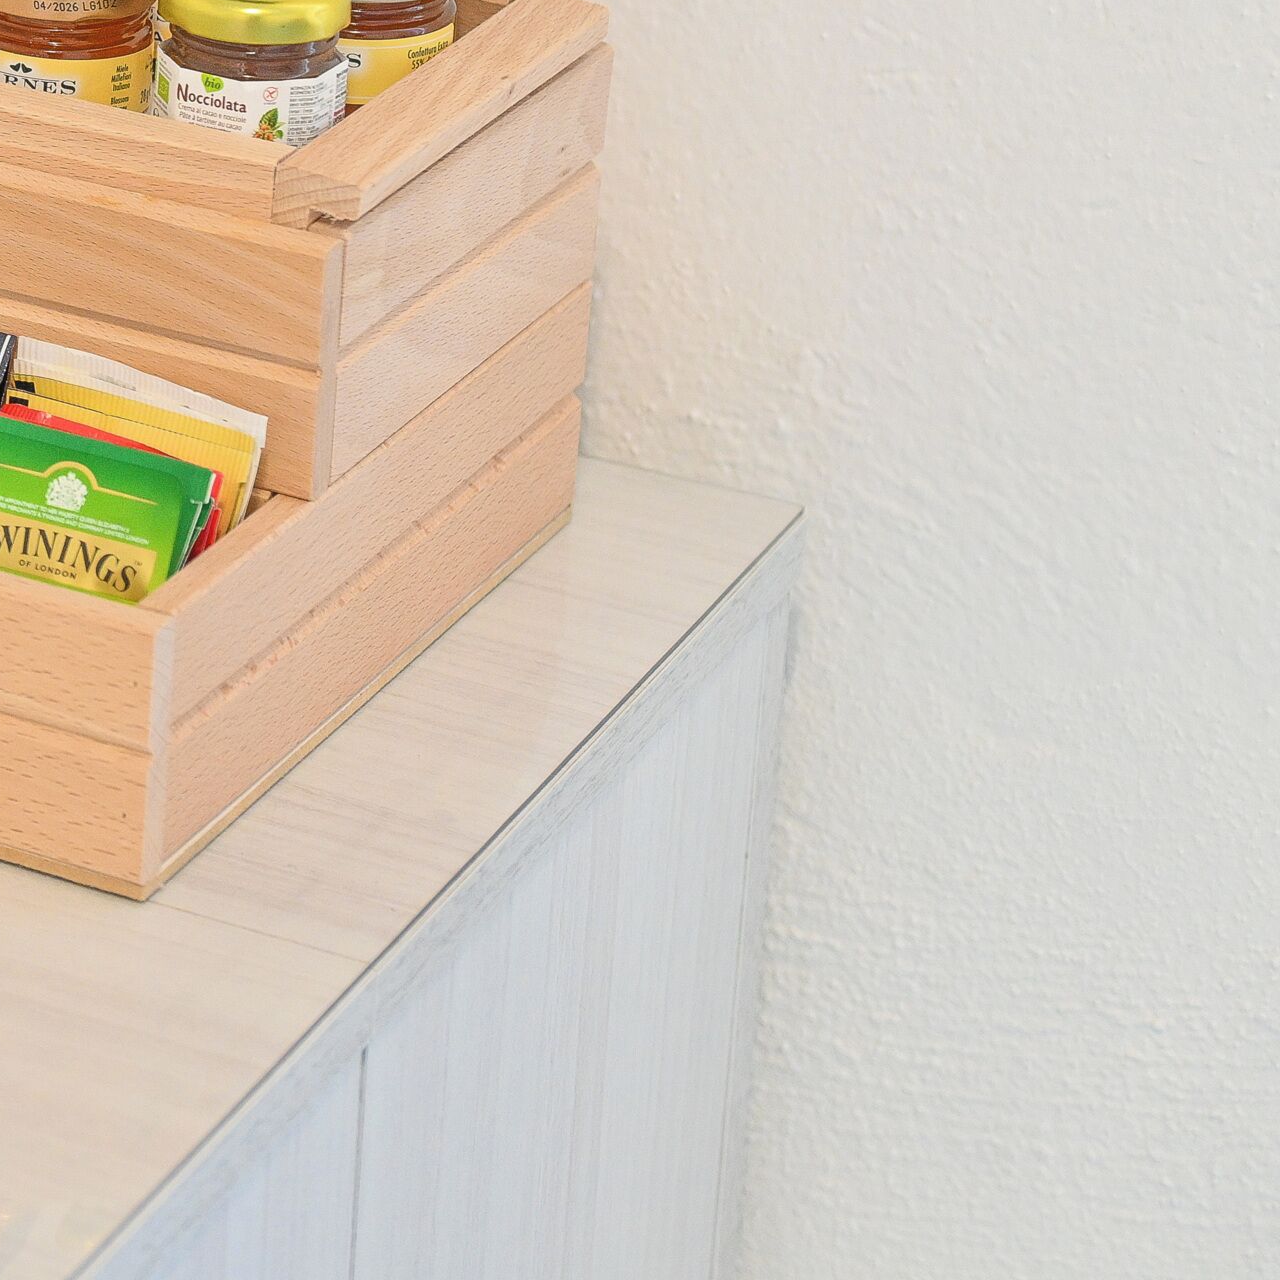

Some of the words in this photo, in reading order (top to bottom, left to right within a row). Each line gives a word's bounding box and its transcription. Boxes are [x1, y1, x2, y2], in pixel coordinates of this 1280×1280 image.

[32, 0, 79, 12] 04/2026
[204, 77, 221, 90] bio
[176, 83, 247, 113] Nocciolata
[18, 559, 32, 568] OF
[34, 564, 78, 580] LONDON
